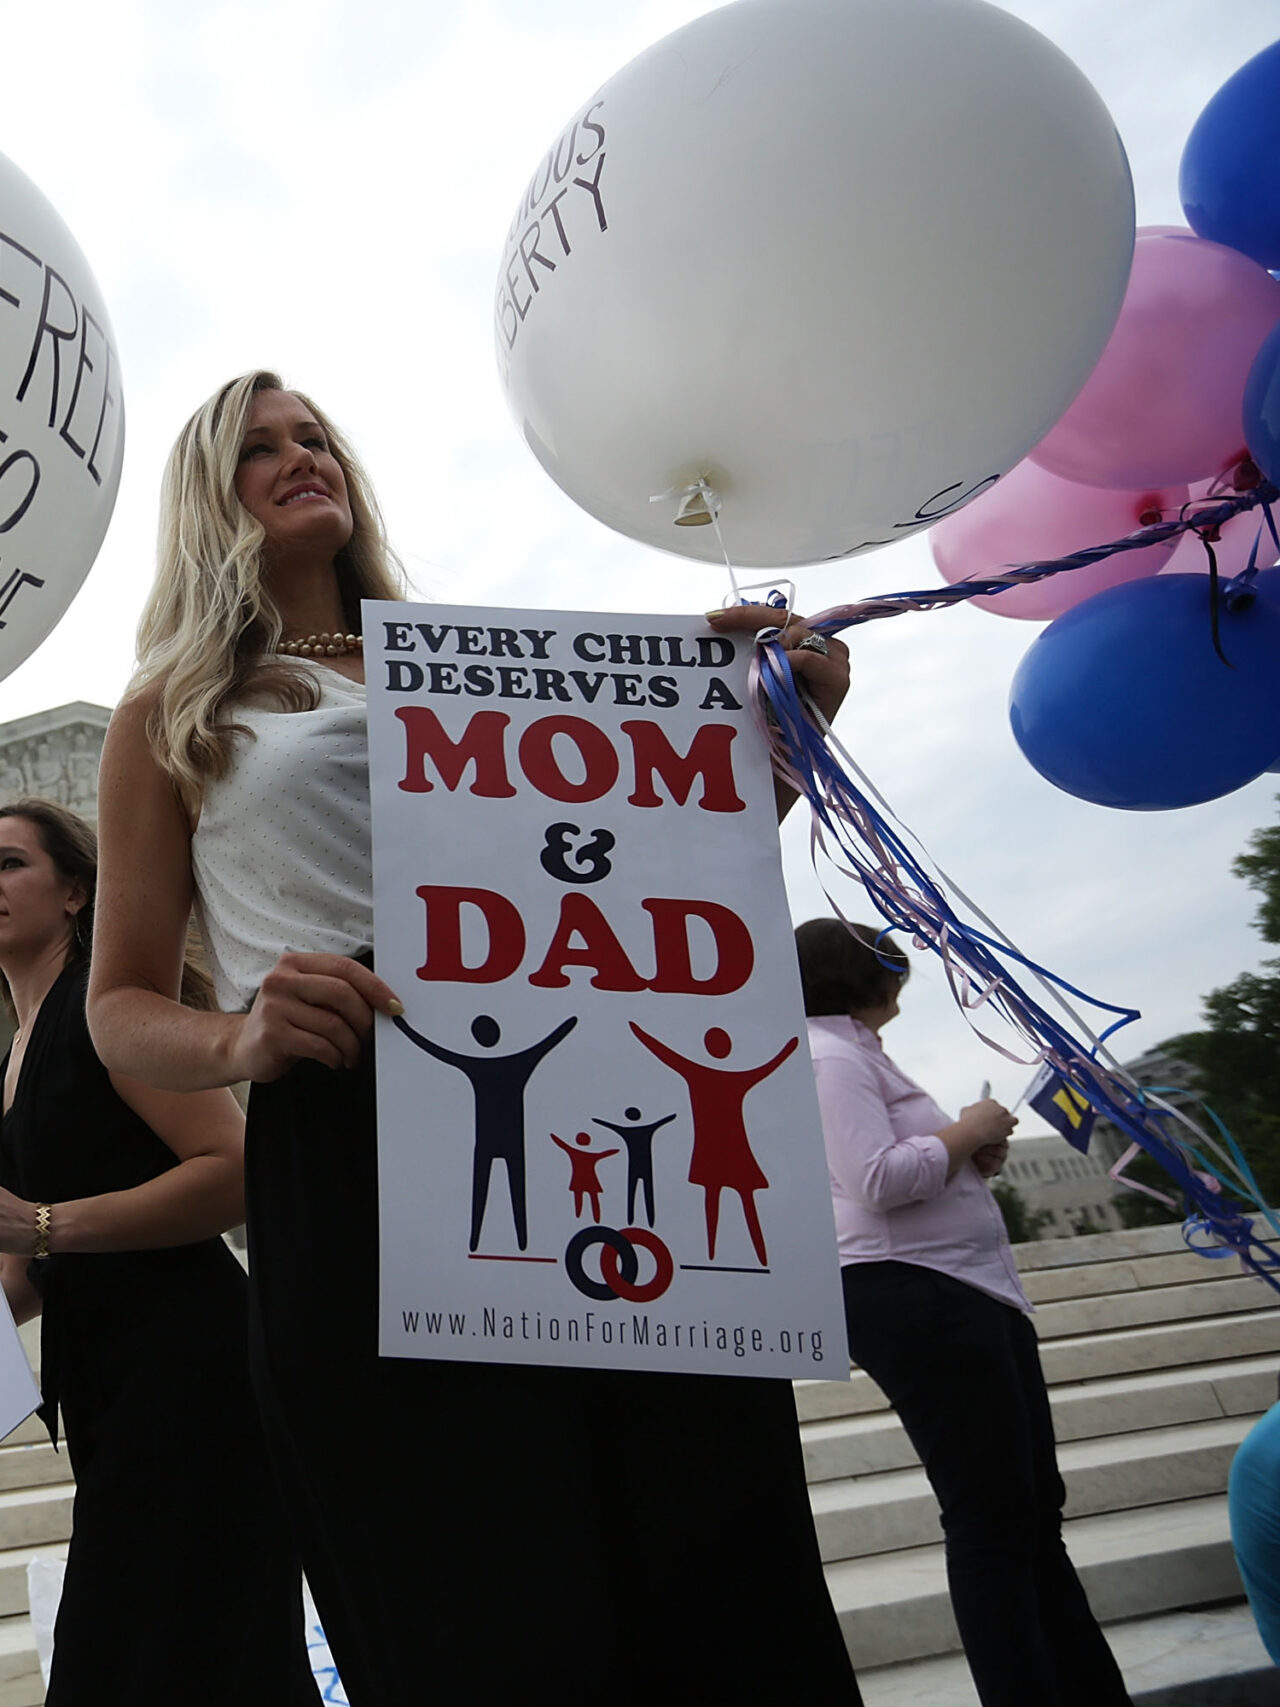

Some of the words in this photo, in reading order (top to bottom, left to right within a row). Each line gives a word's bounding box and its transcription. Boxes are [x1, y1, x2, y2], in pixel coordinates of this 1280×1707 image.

[497, 152, 608, 351] BERTY
[382, 621, 557, 660] EVERY
[572, 632, 736, 667] CHILD
[385, 660, 680, 709] DESERVES
[698, 677, 743, 710] A
[394, 705, 747, 813] MOM
[540, 821, 616, 884] &
[415, 884, 755, 996] DAD
[402, 1307, 824, 1362] www.NationForMarriage.org
